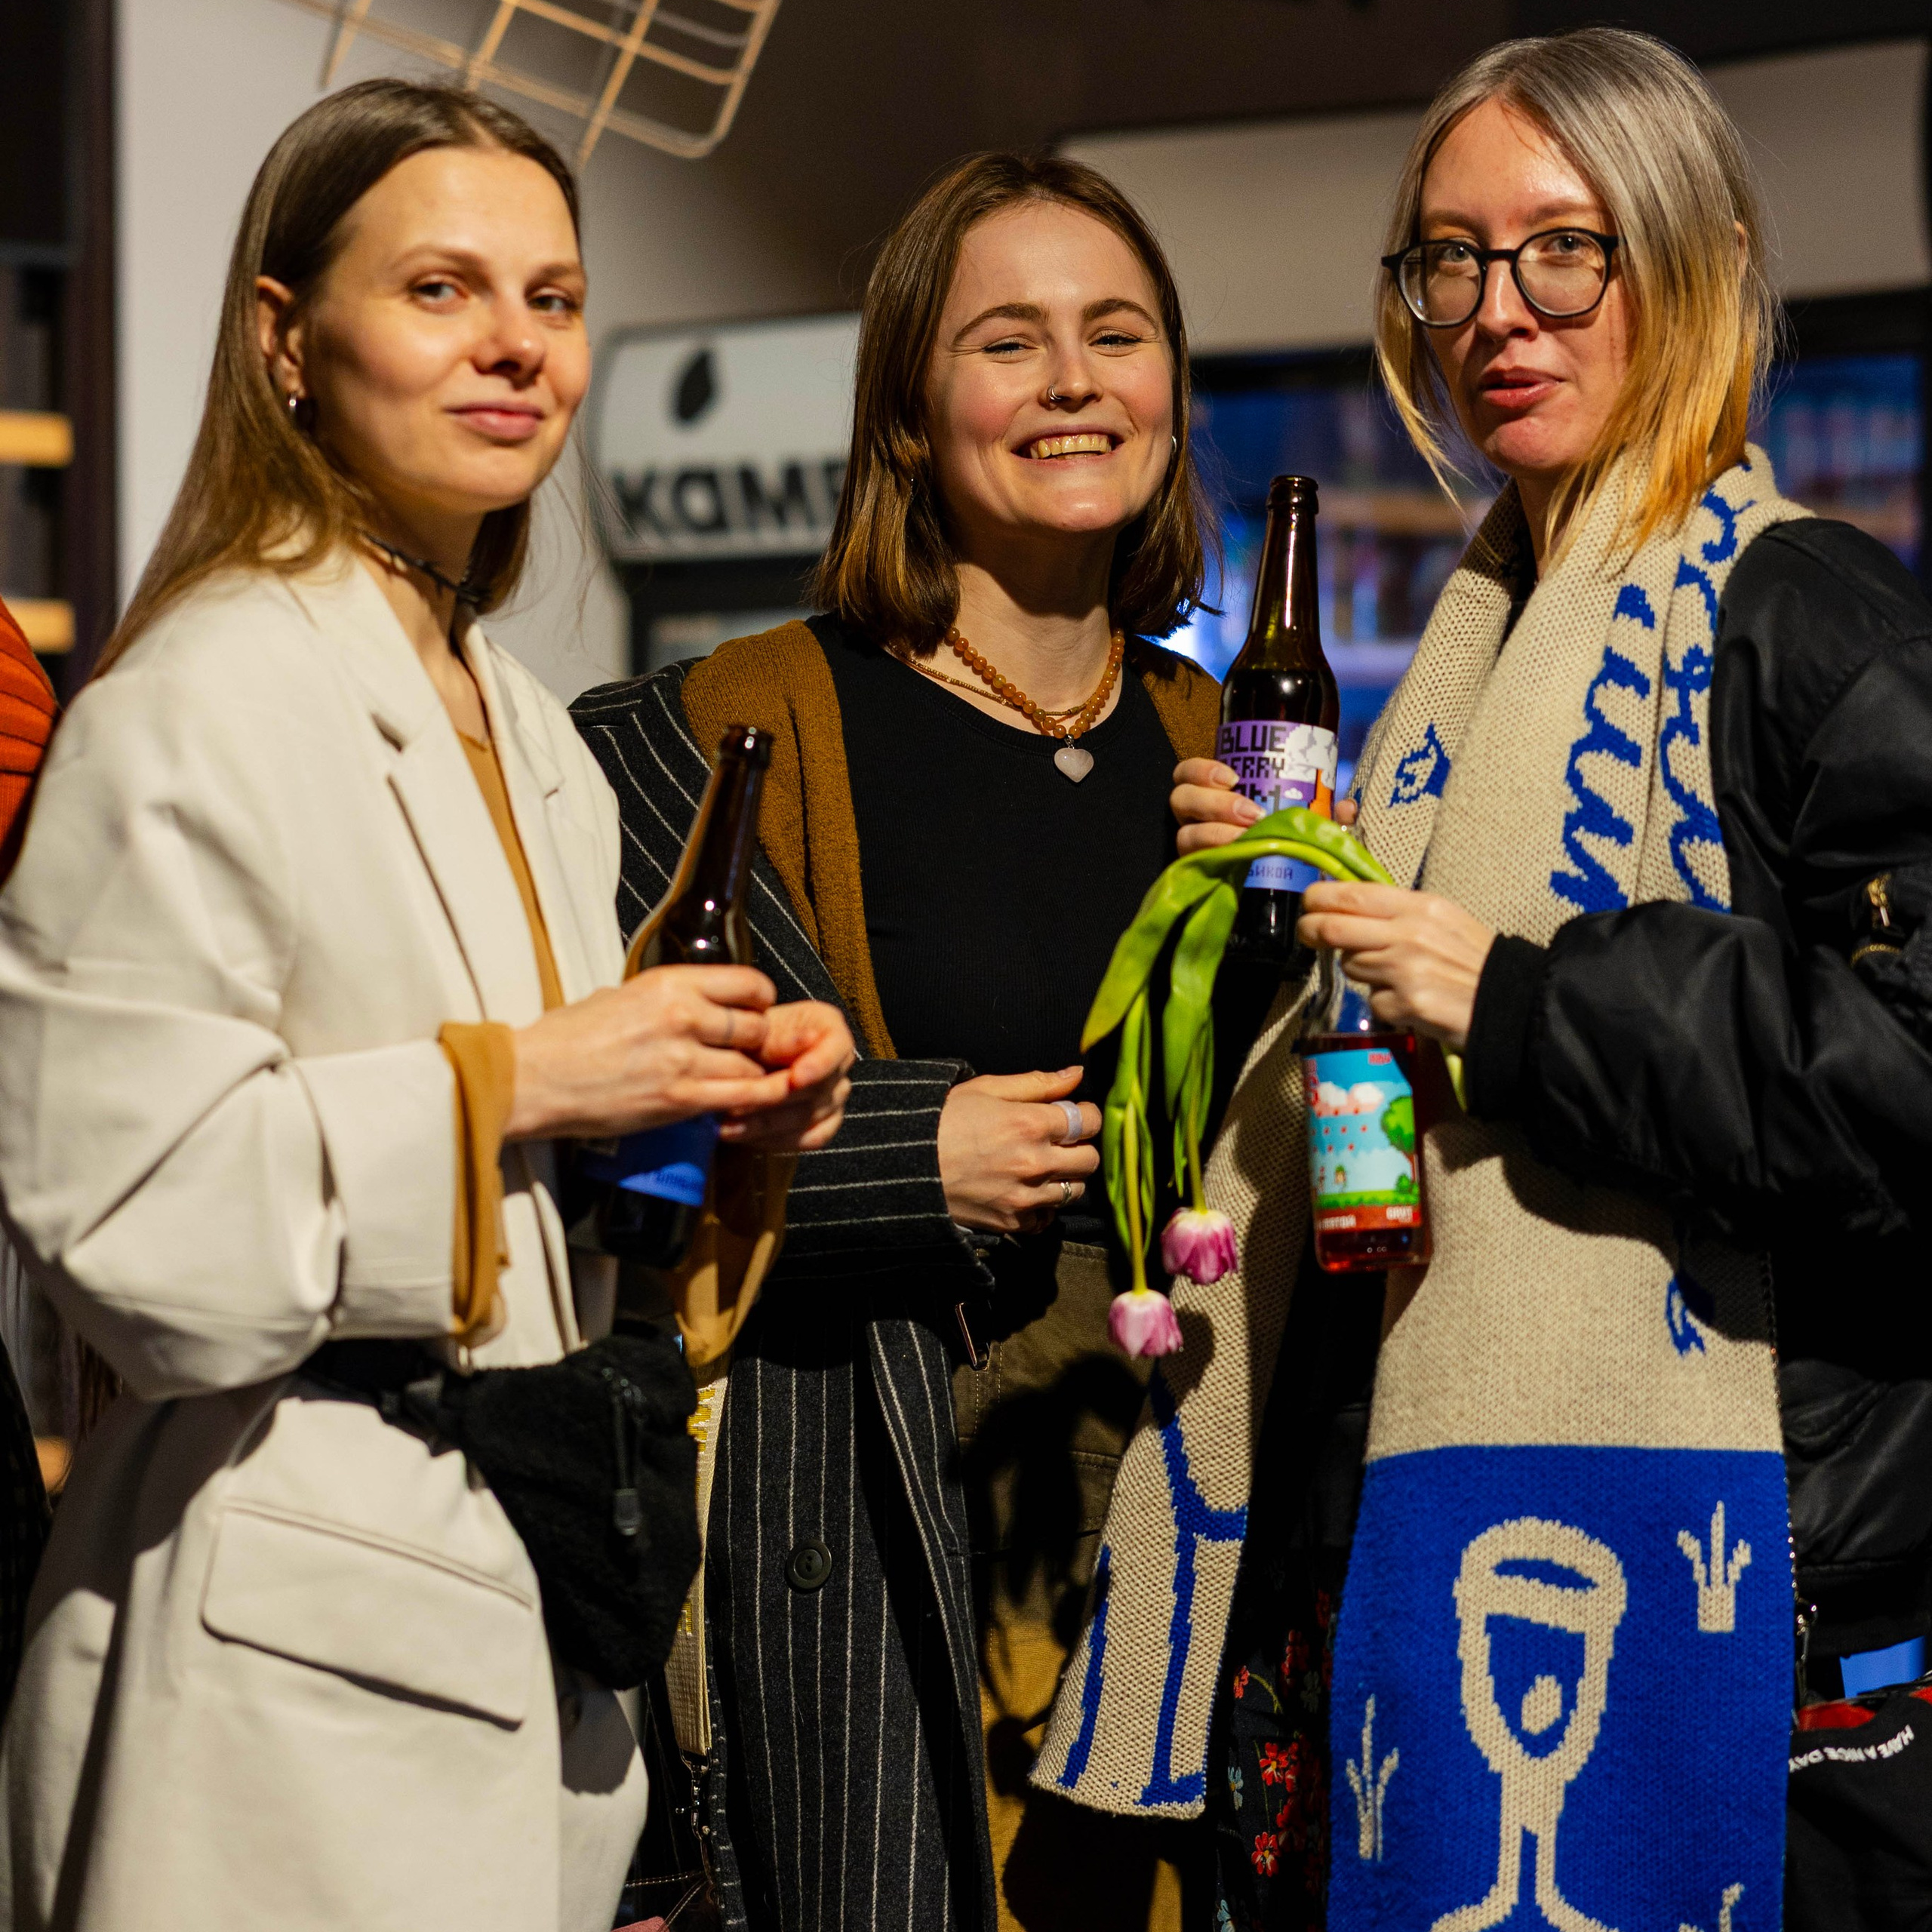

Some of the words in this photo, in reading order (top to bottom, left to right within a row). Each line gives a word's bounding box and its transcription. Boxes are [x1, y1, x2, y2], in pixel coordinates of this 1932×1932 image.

[1221, 724, 1286, 753] BLUE
[1221, 756, 1284, 779] ERRY
[1864, 1745, 1877, 1759] A
[1877, 1724, 1915, 1758] HAVE
[1788, 1749, 1825, 1774] DAY
[1823, 1746, 1866, 1762] NICE
